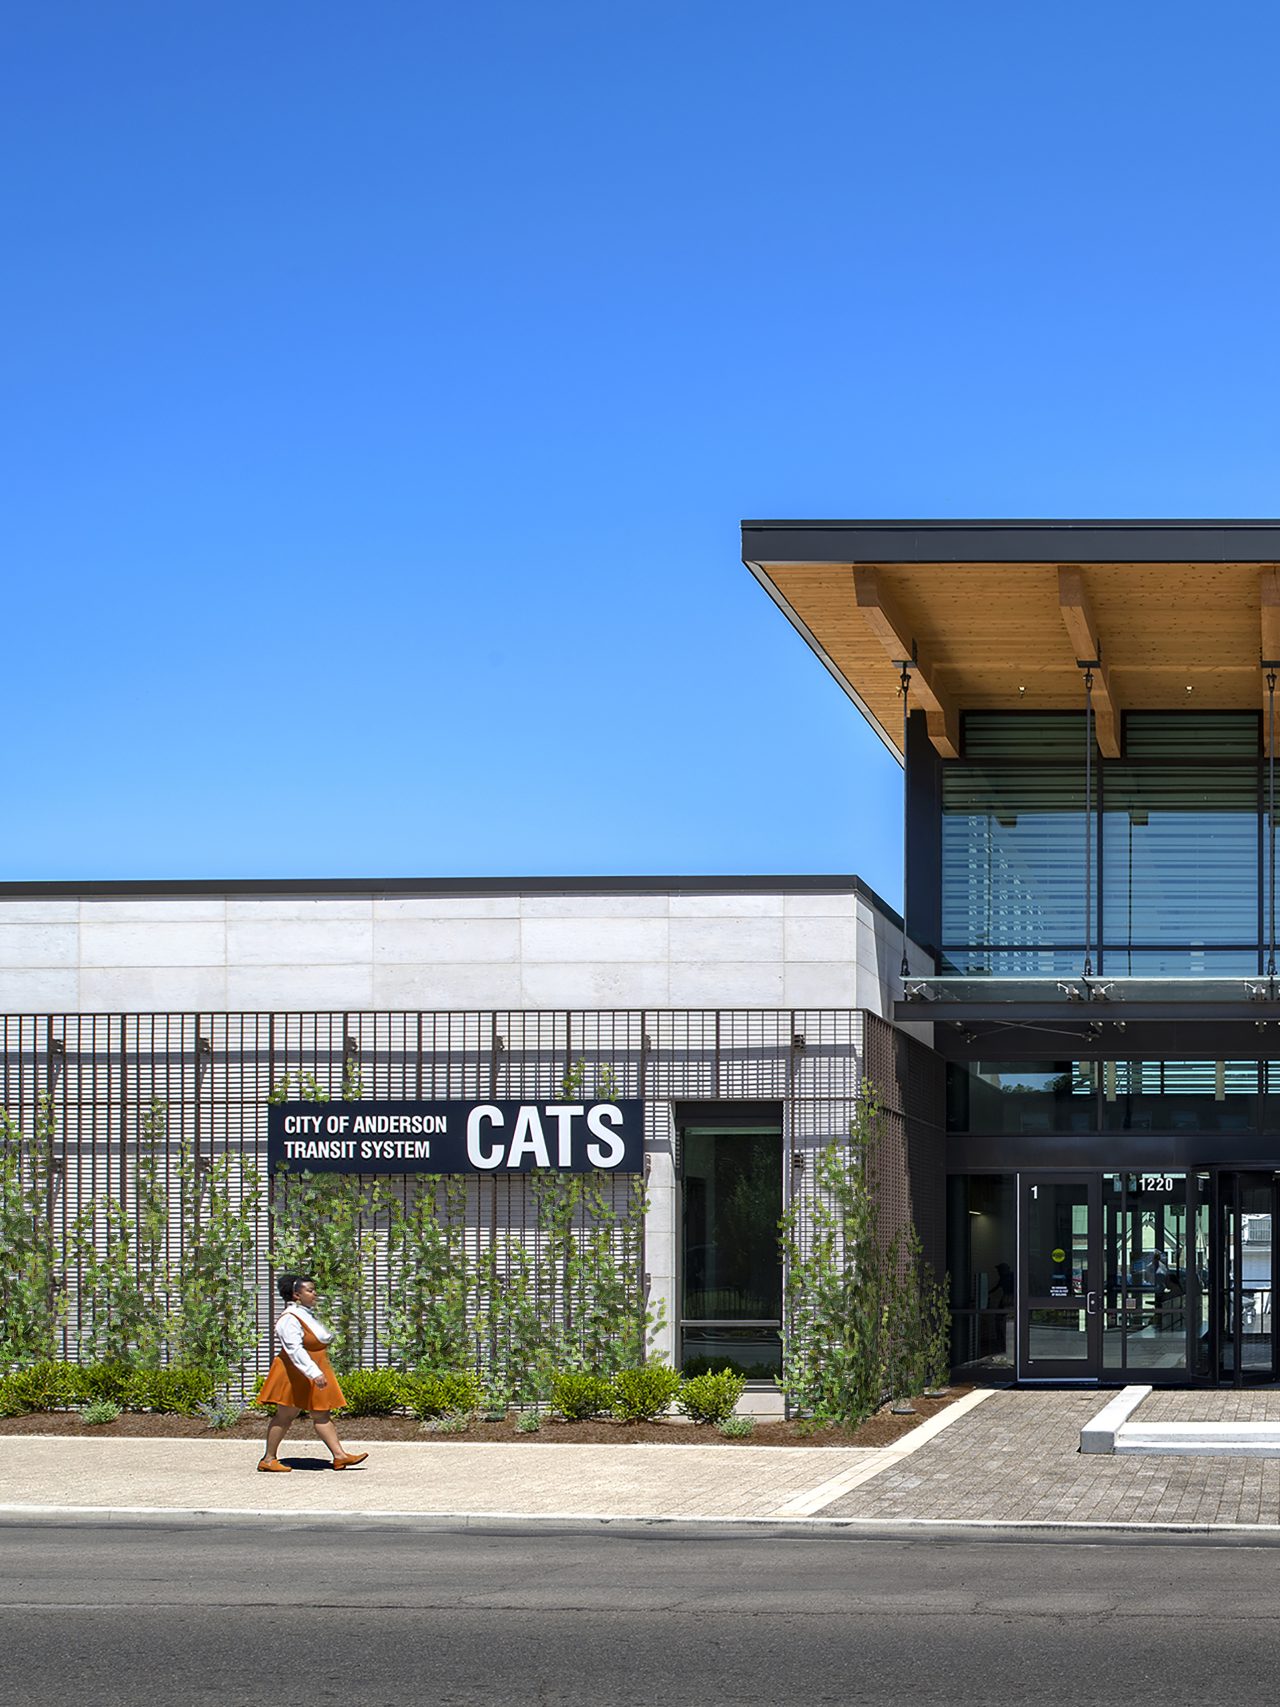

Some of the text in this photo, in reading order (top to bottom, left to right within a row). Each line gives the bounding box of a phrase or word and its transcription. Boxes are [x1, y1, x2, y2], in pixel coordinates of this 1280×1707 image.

[284, 1115, 447, 1134] CITY OF ANDERSON
[466, 1104, 625, 1169] CATS
[284, 1140, 430, 1159] TRANSIT SYSTEM
[1031, 1185, 1038, 1199] 1
[1139, 1178, 1173, 1191] 1220
